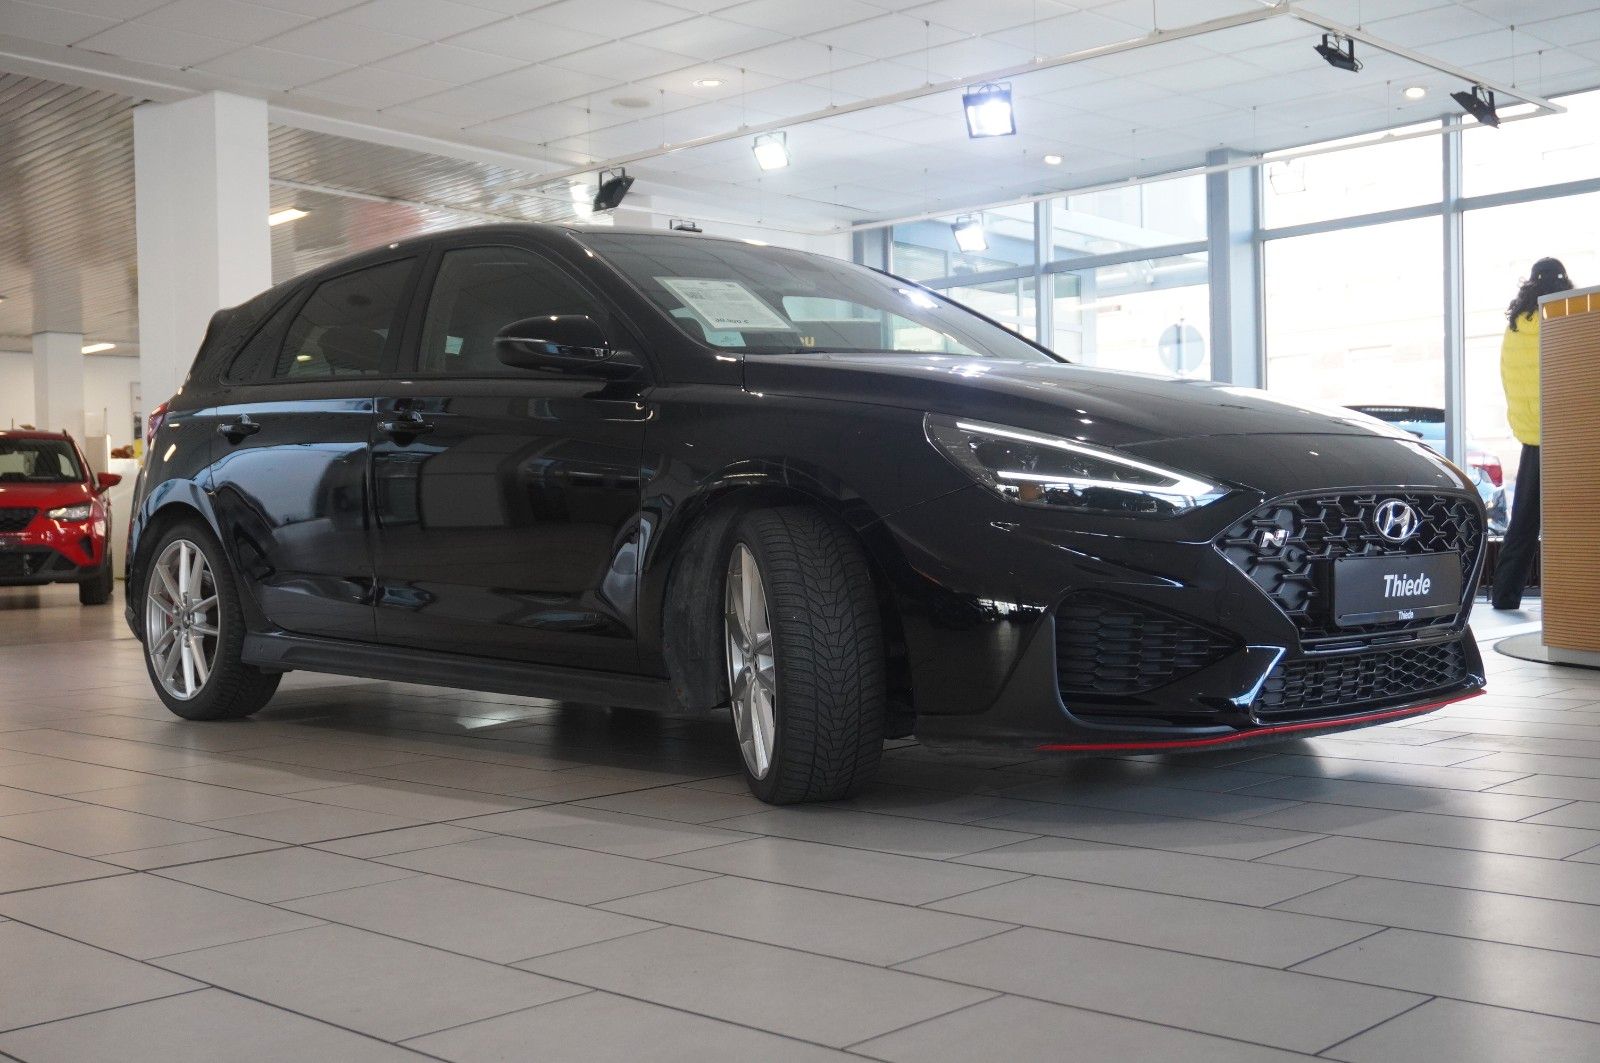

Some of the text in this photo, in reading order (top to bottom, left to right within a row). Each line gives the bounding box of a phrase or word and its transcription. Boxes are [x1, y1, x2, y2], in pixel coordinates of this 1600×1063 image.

[1260, 529, 1289, 548] N
[1384, 573, 1430, 598] Thiede
[1398, 609, 1414, 620] Thiede
